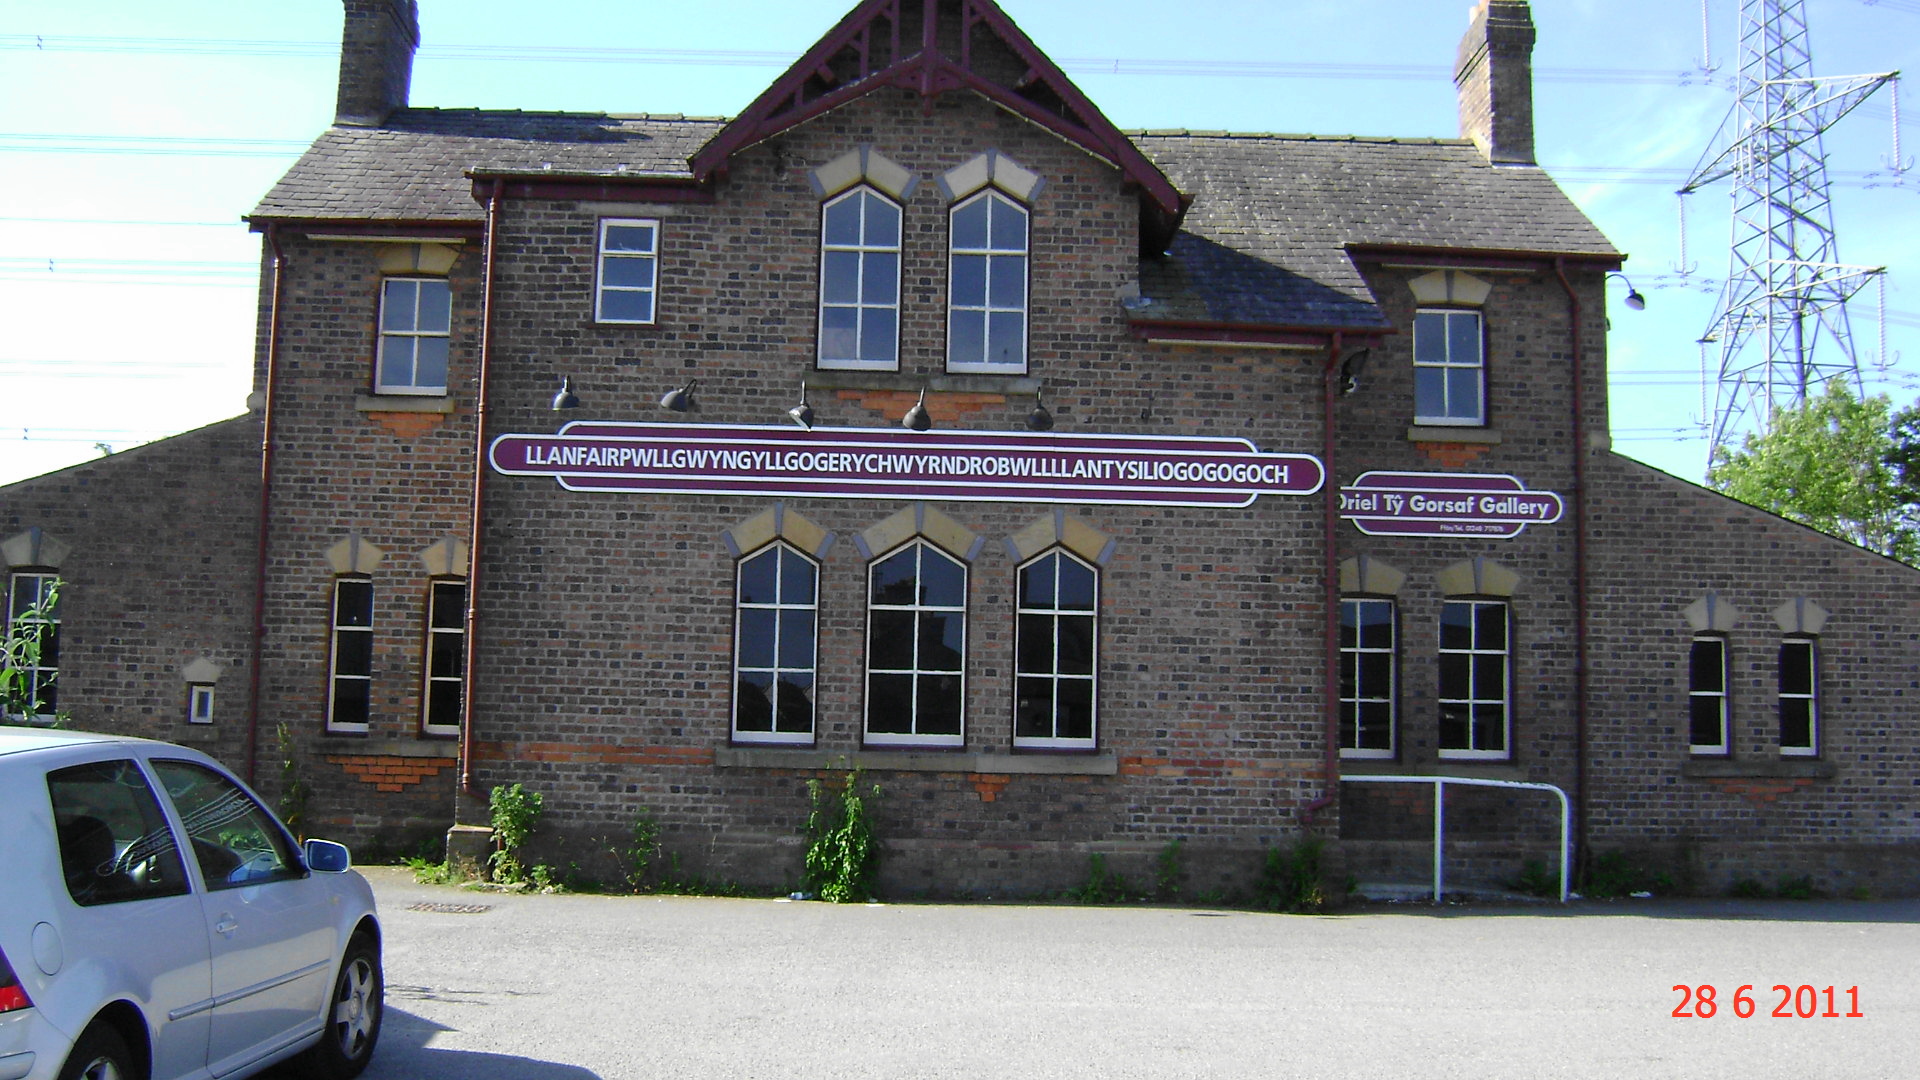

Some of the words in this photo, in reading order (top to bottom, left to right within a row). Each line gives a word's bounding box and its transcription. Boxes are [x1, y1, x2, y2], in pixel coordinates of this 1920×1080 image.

[525, 446, 1288, 484] LLANFAIRPWLLGWYNGYLLGOGERYCHWYRNDROBWLLLLANTYSILIOGOGOGOCH
[1409, 495, 1474, 513] Gorsaf
[1480, 496, 1550, 518] Gallery
